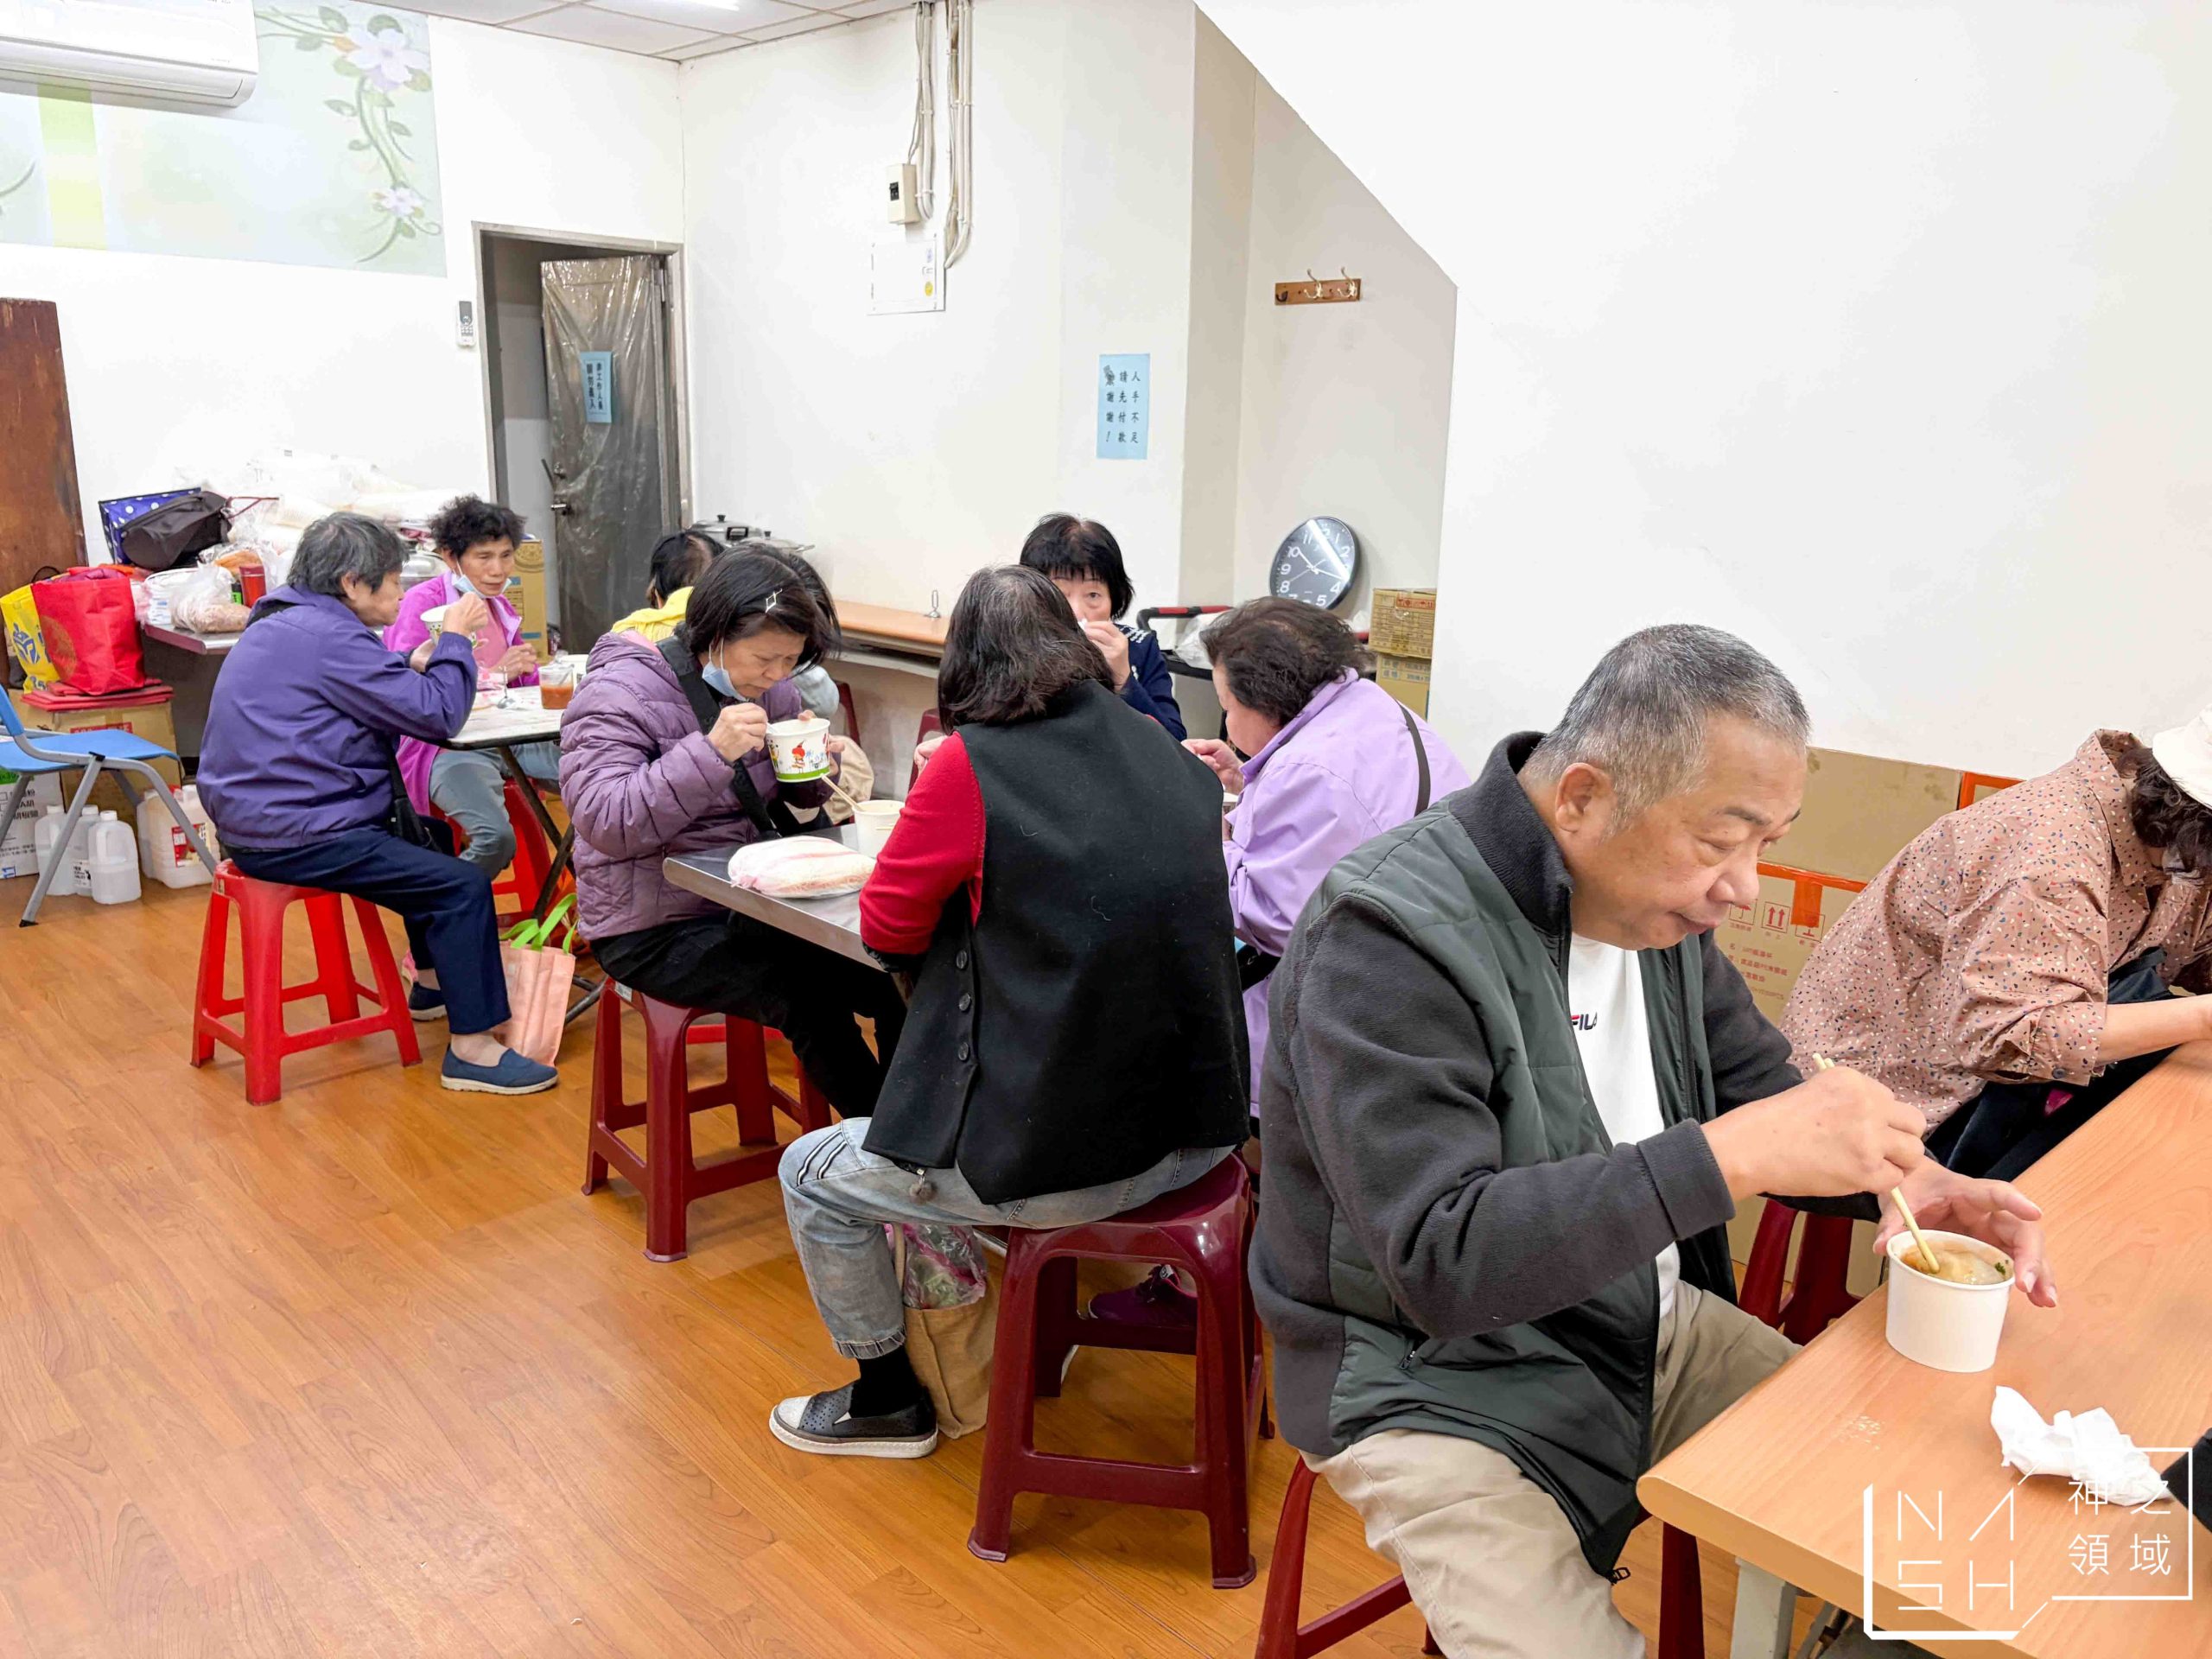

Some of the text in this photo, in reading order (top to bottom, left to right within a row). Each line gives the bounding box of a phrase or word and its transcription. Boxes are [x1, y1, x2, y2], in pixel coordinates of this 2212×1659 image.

[1117, 371, 1128, 442] 請先付款
[1130, 371, 1141, 443] 人手不足
[1287, 545, 1300, 558] 10
[1338, 545, 1351, 558] 2
[1280, 563, 1292, 575] 9
[1279, 580, 1291, 594] 8
[1329, 581, 1342, 594] 4
[1315, 594, 1327, 607] 5
